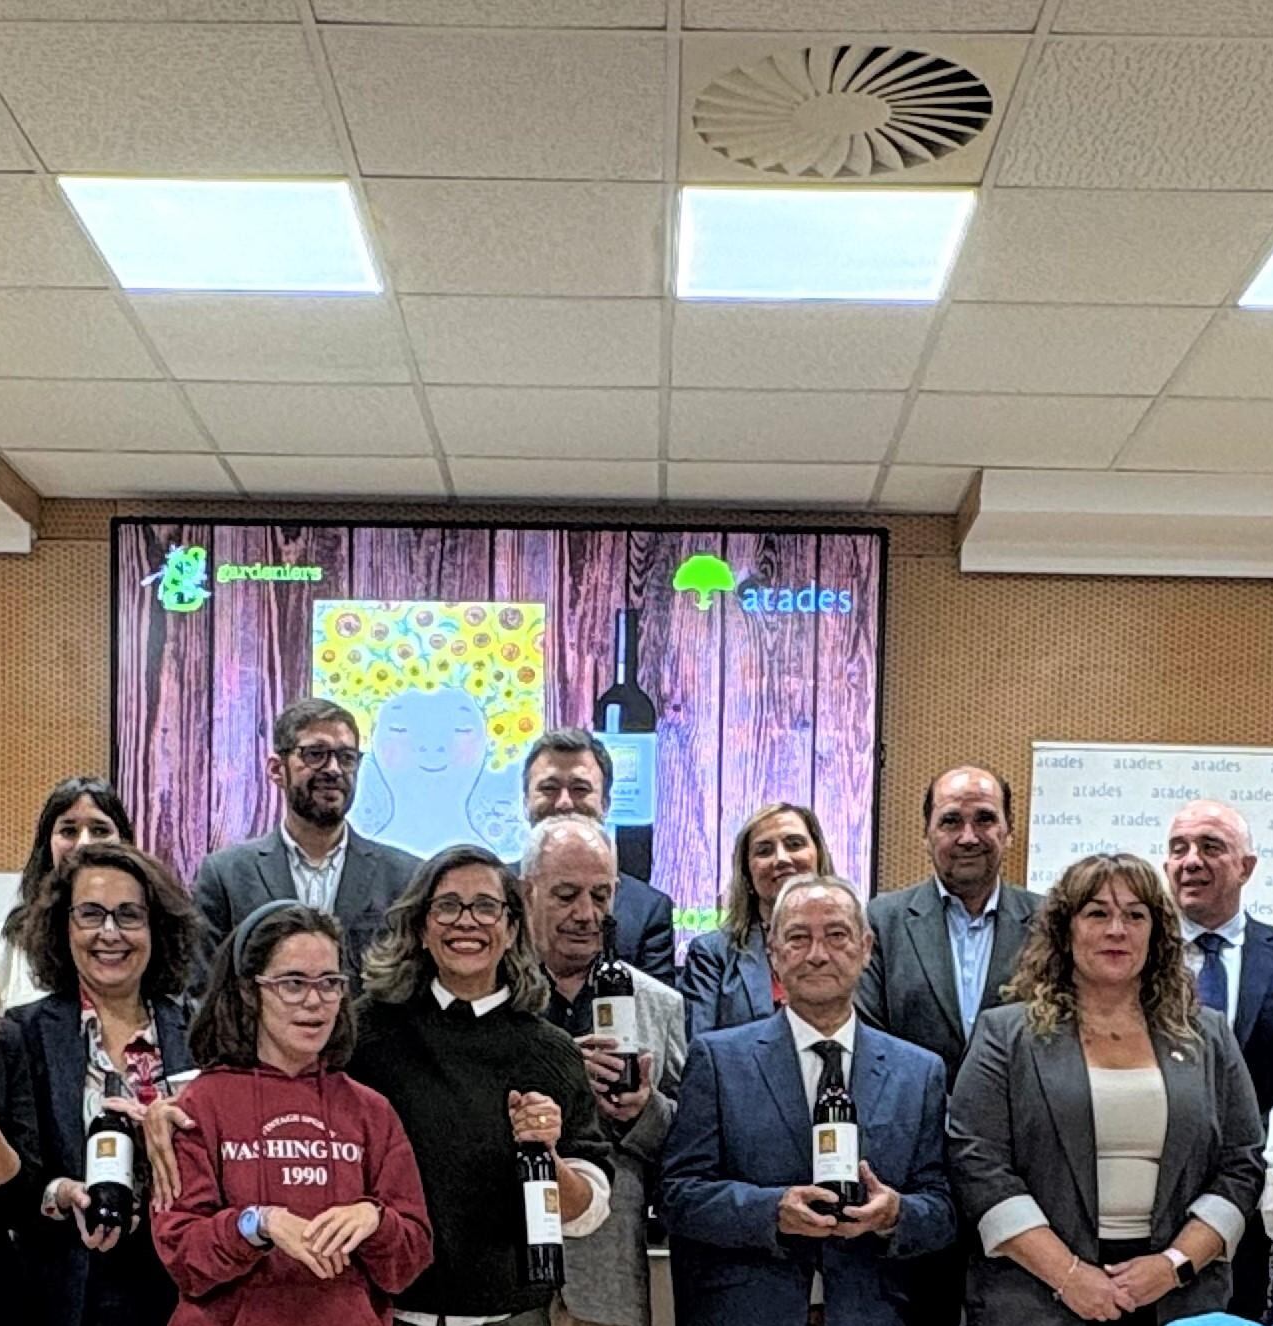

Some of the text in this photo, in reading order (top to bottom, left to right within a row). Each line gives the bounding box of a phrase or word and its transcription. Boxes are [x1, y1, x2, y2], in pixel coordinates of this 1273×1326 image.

[743, 580, 852, 613] atades
[1036, 755, 1084, 769] atades
[1113, 757, 1163, 771] atades
[1191, 760, 1241, 773] atades
[1072, 784, 1122, 797] atades
[1151, 786, 1201, 799] atades
[1032, 812, 1082, 825] atades
[1111, 812, 1161, 827] atades
[282, 1167, 328, 1185] 1990
